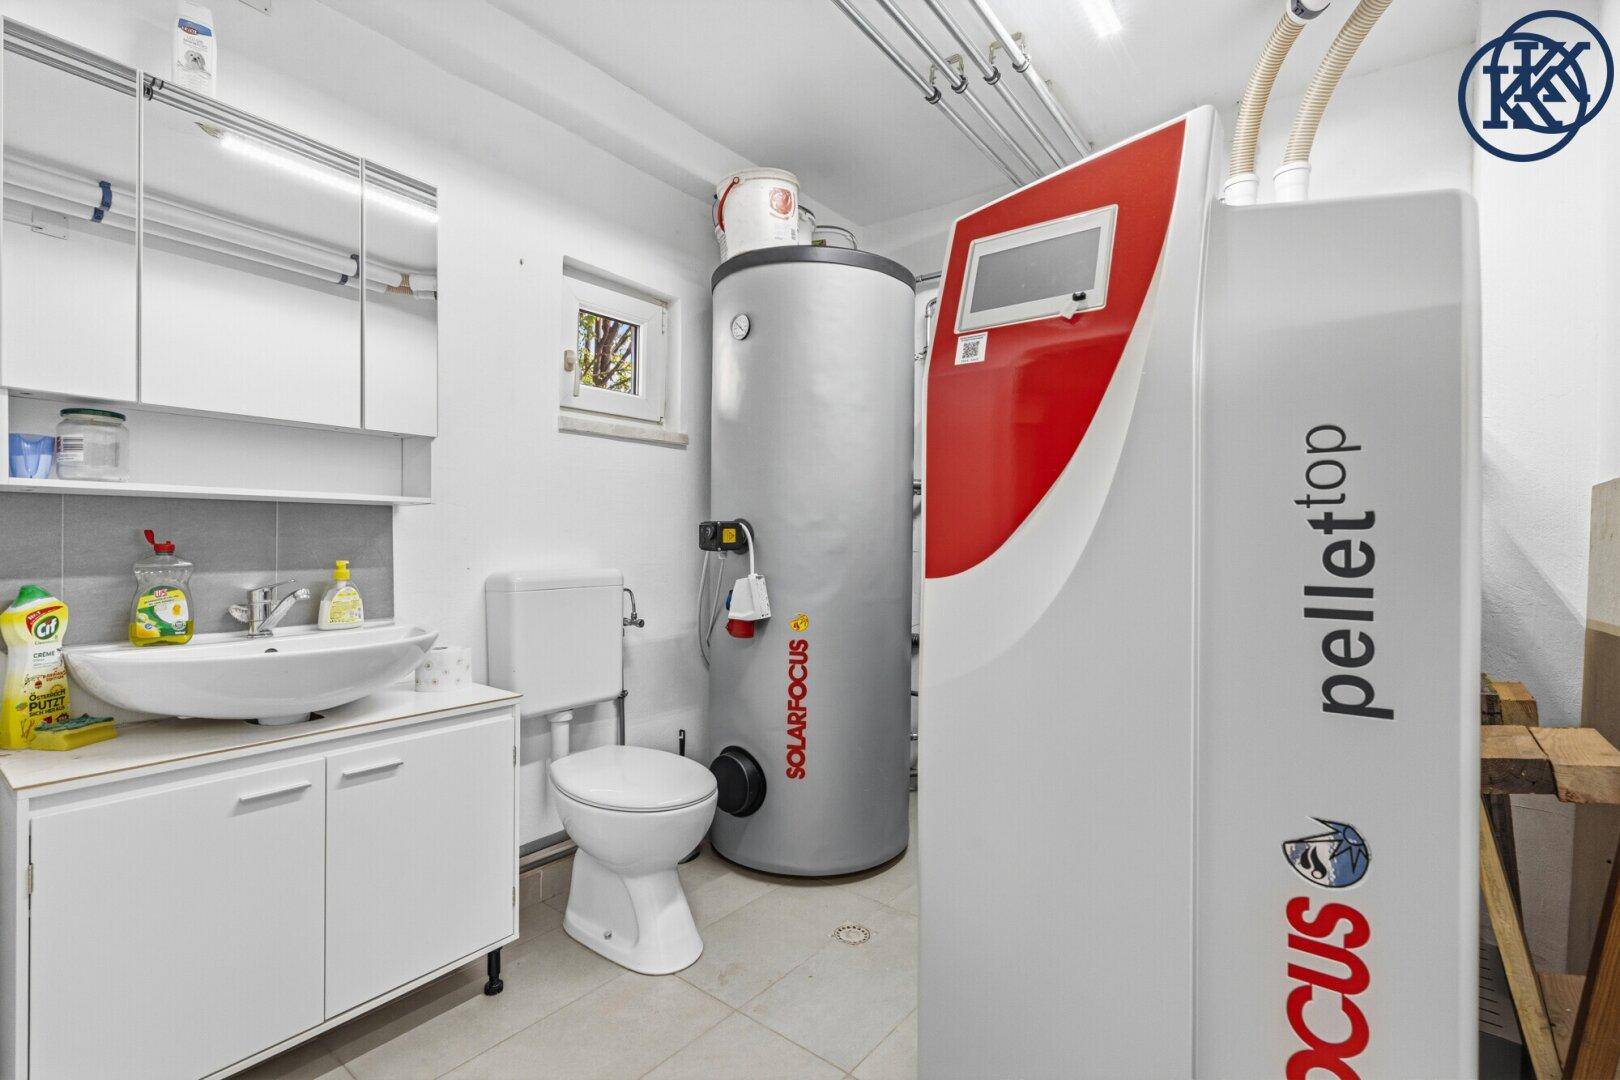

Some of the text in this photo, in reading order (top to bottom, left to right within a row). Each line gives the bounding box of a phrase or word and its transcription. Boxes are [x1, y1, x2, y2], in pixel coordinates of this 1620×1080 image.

[36, 617, 58, 637] Cif
[29, 696, 66, 712] PUTZT
[786, 638, 809, 780] SOLARFOCUS
